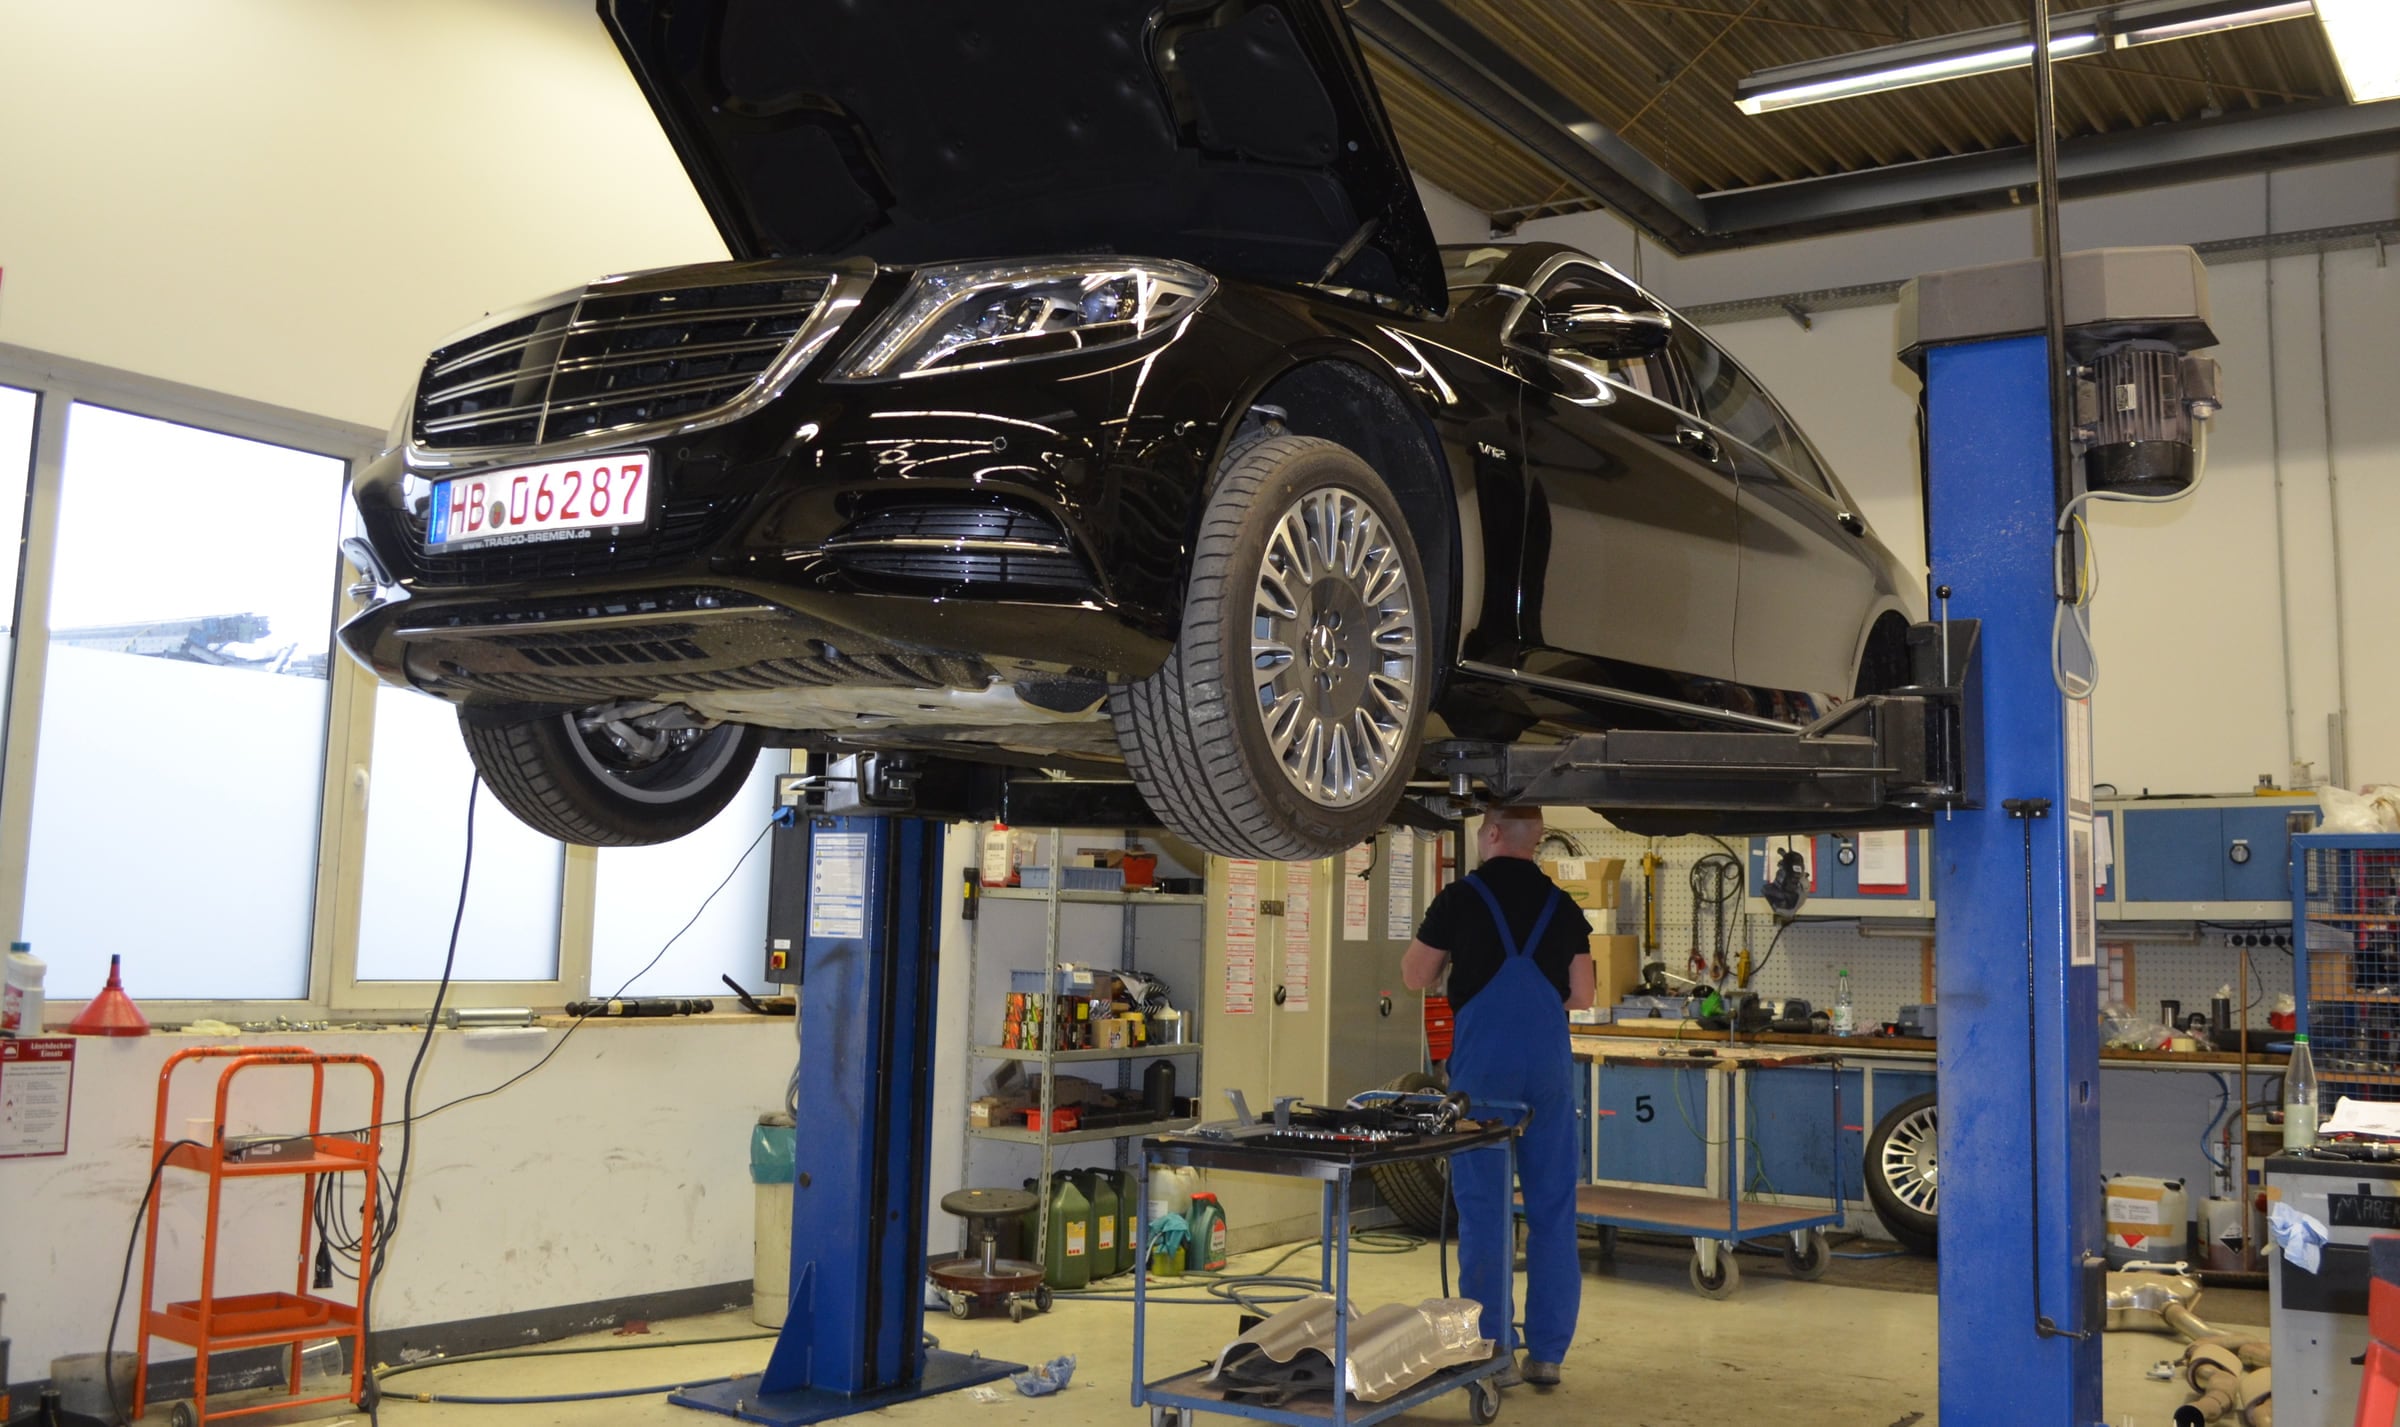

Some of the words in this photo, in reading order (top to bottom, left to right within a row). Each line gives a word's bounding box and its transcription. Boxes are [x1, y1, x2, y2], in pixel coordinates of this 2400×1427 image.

[1478, 441, 1506, 460] V12
[449, 482, 485, 534] HB
[510, 464, 643, 525] 06287
[462, 529, 592, 550] www.TRASCO-BREMEN.de
[1635, 1095, 1655, 1123] 5
